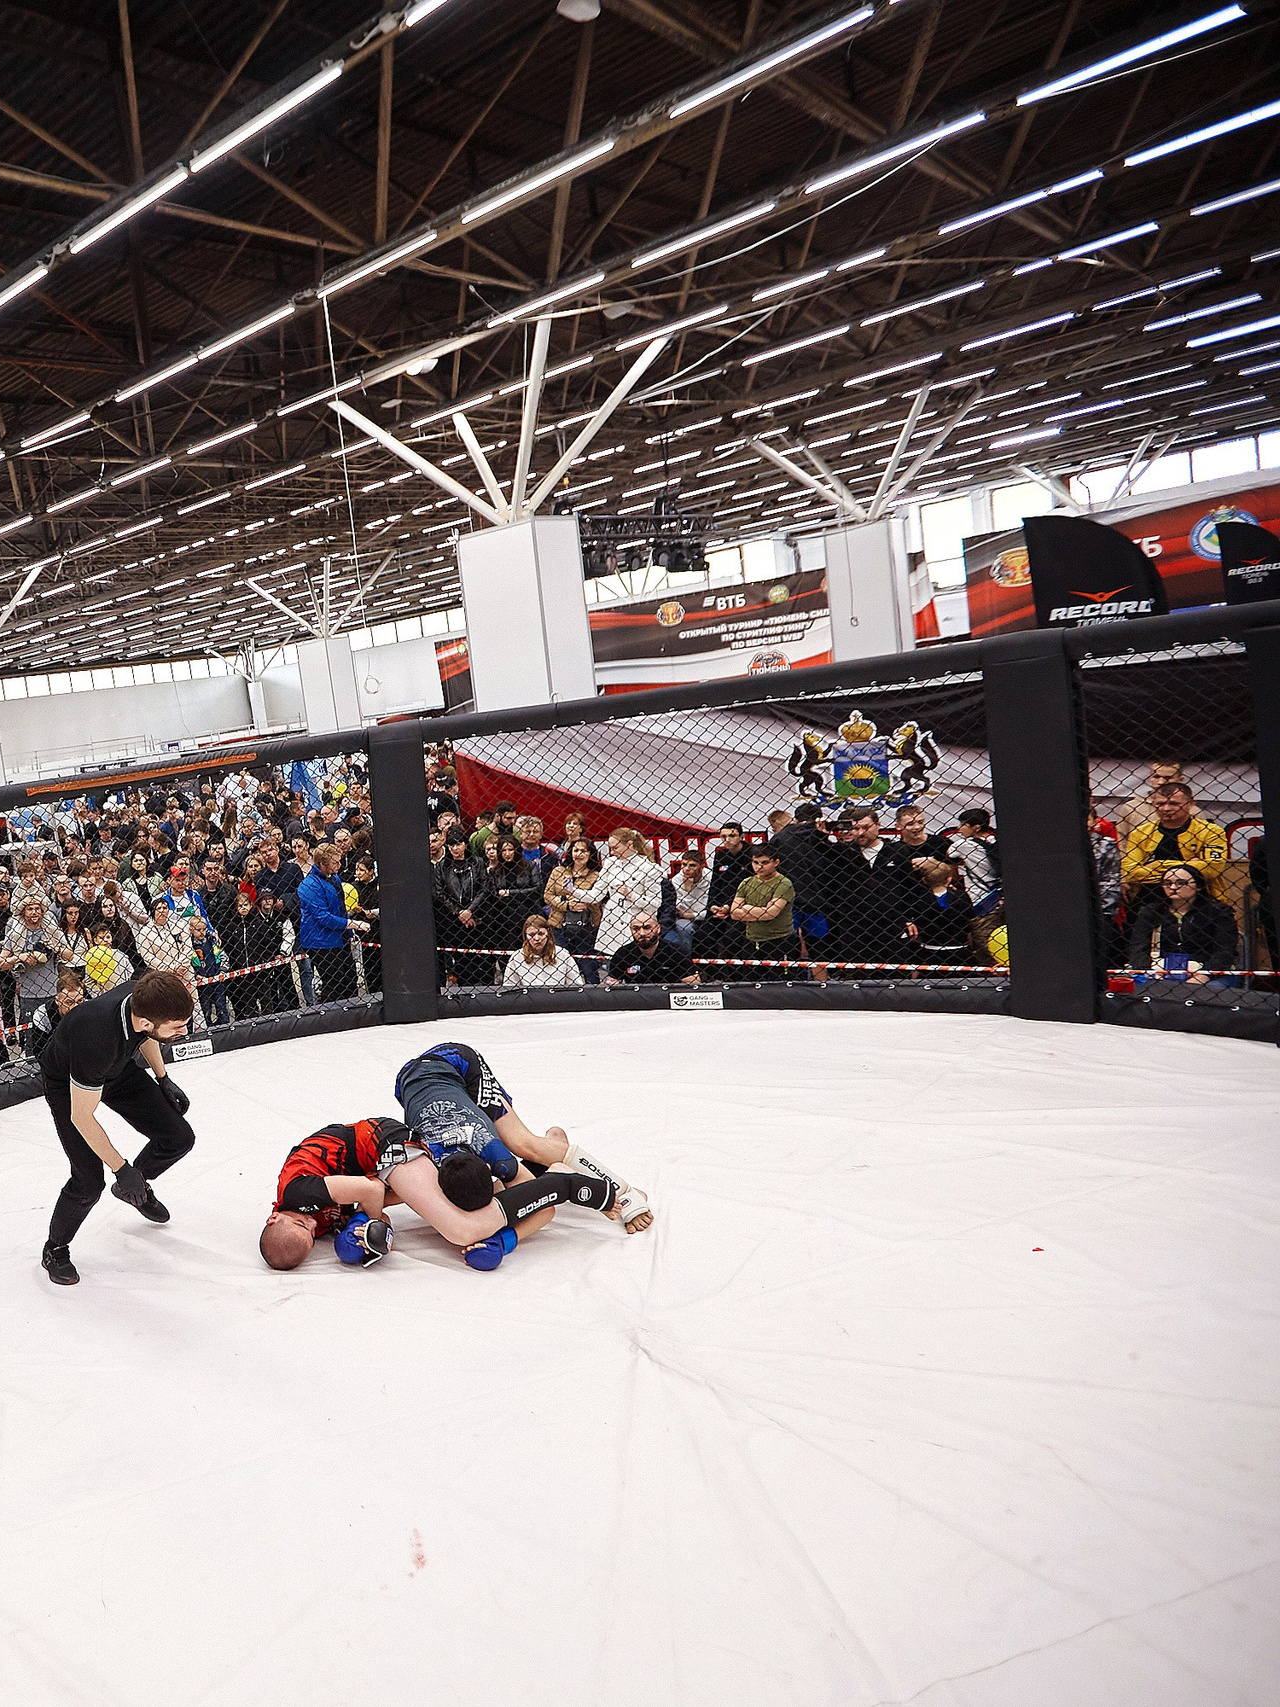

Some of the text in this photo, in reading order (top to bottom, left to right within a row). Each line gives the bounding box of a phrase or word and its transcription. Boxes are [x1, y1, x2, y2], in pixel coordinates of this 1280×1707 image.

[717, 594, 746, 611] ВТБ
[1049, 601, 1152, 621] RECORD
[678, 623, 727, 639] ОТКРЫТЫЙ
[728, 619, 762, 631] ТУРНИР
[720, 620, 812, 641] ПО СТРИТЛИФТИНГУ
[731, 640, 744, 649] ПО
[745, 635, 781, 647] ВЕРСИИ
[751, 664, 789, 675] ТЮМЕНЬ
